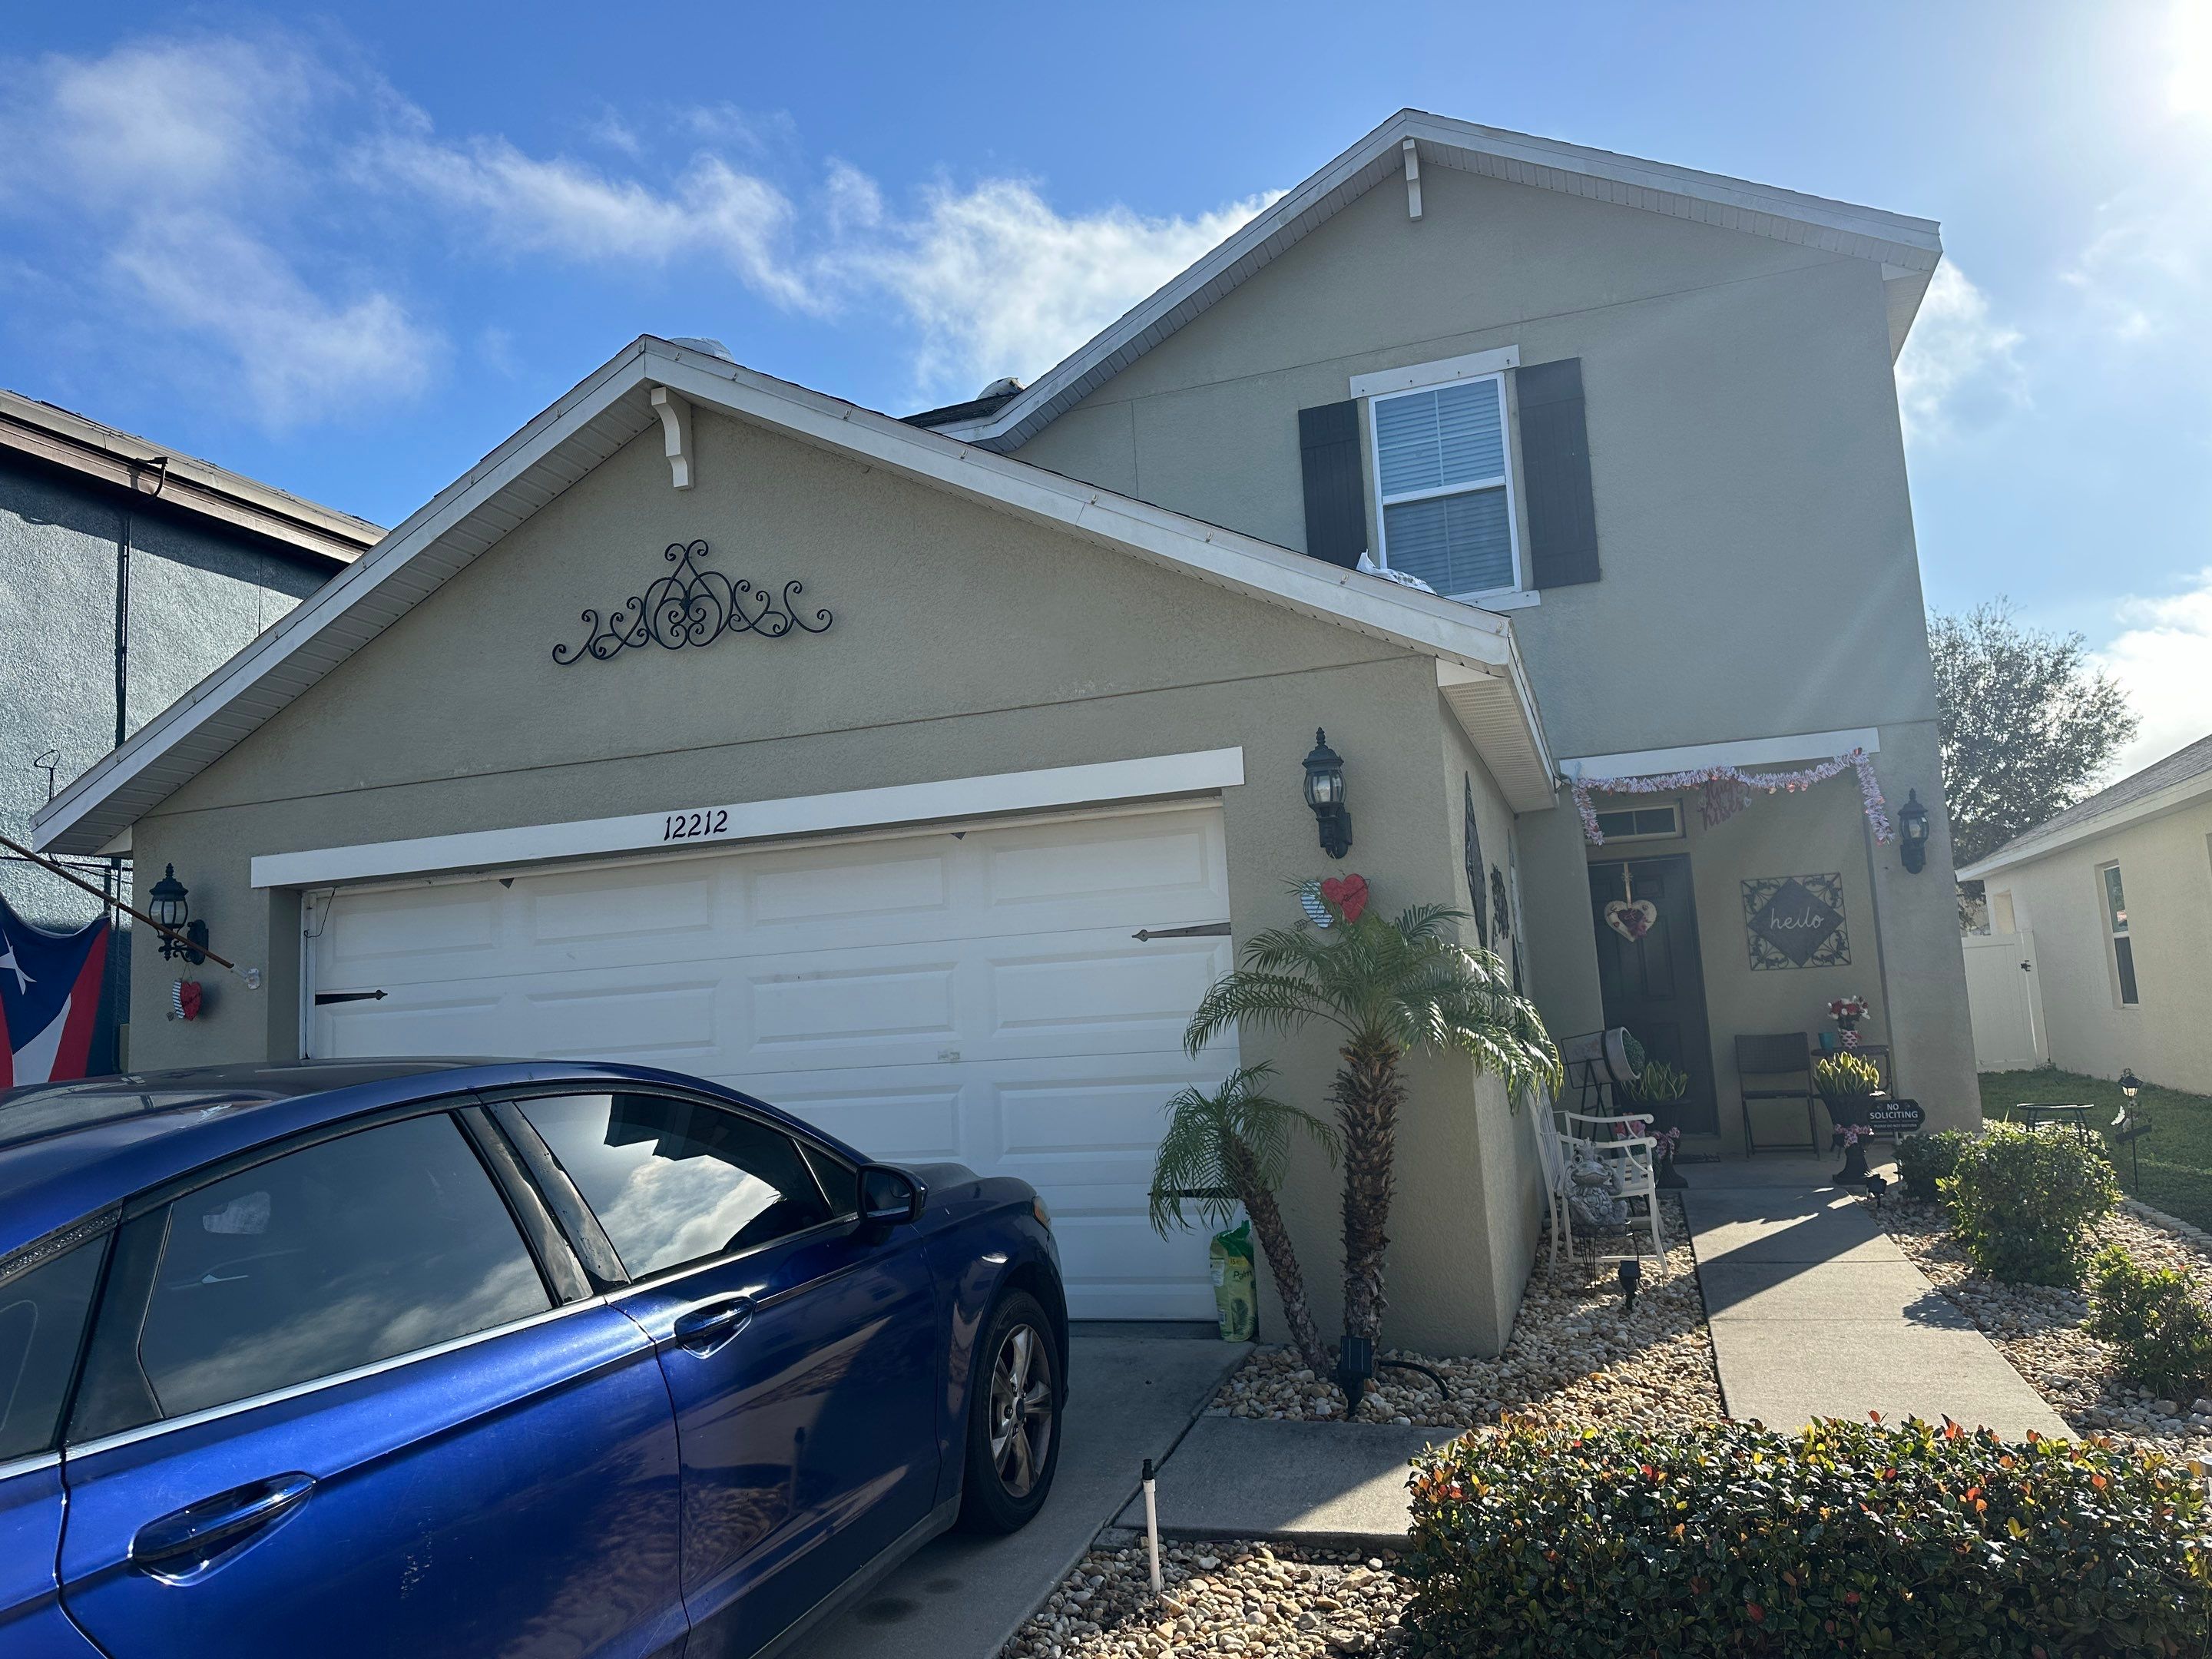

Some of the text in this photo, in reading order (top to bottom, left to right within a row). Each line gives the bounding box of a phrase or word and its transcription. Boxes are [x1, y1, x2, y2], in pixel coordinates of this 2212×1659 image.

[664, 810, 728, 841] 12212
[1770, 906, 1824, 929] hello
[1233, 1270, 1252, 1280] Palm
